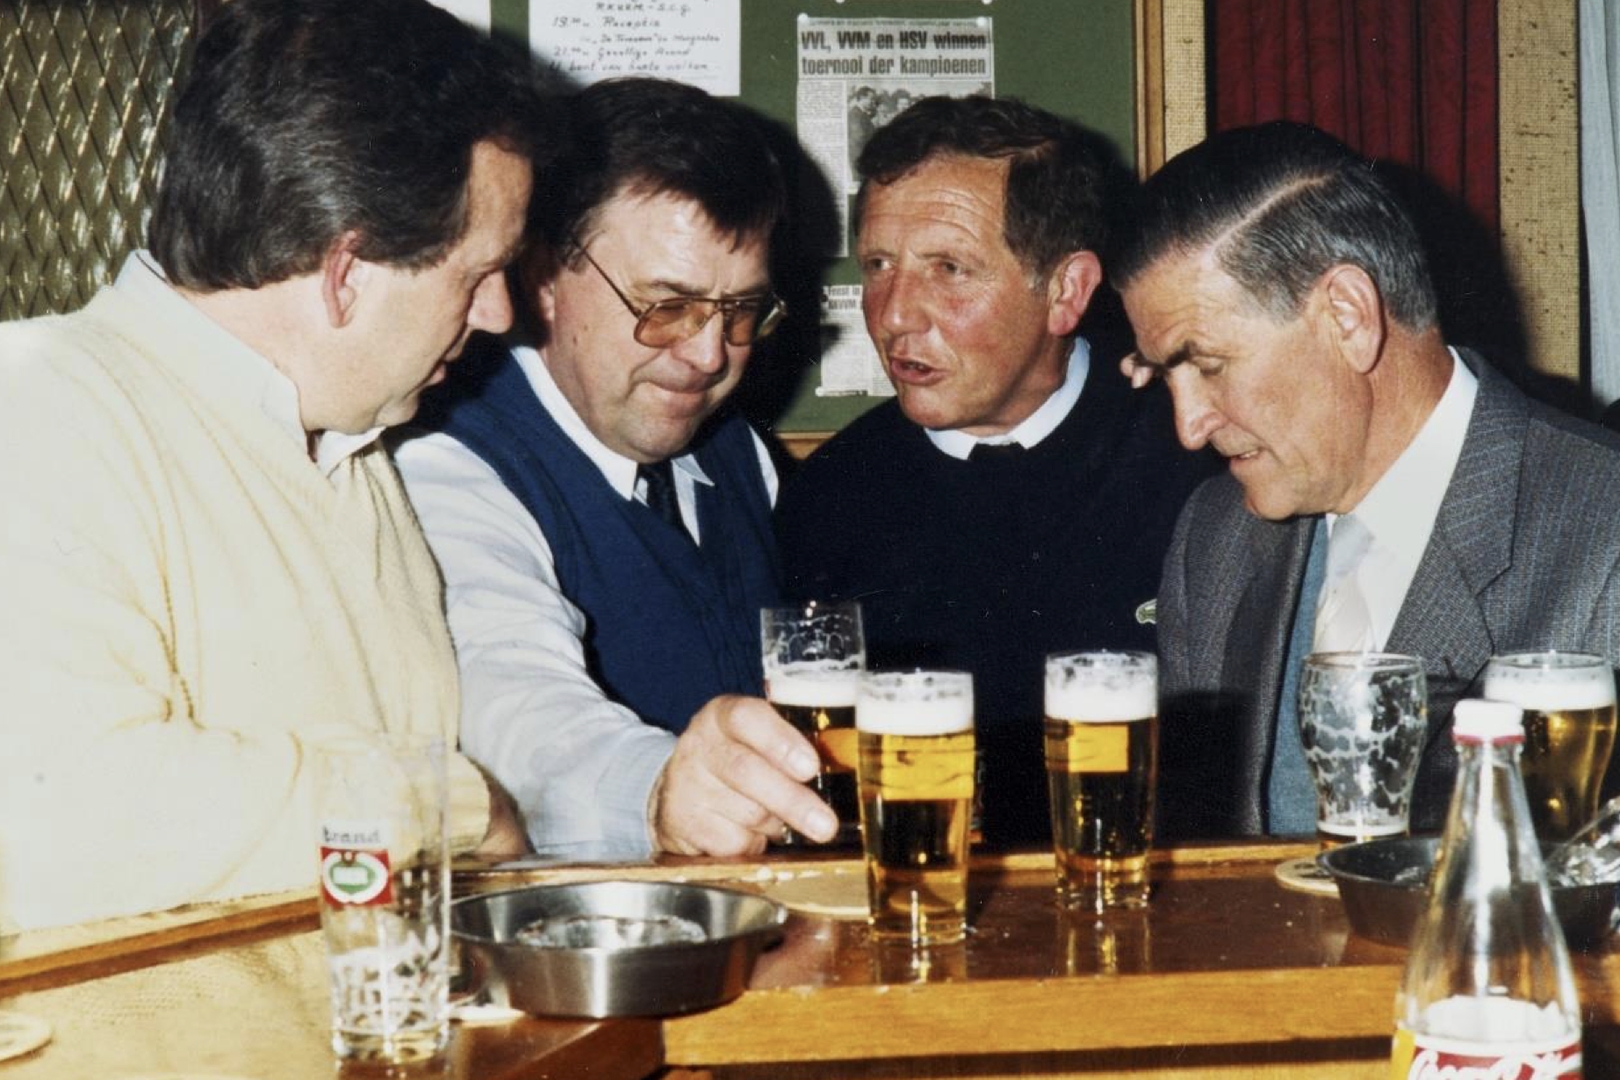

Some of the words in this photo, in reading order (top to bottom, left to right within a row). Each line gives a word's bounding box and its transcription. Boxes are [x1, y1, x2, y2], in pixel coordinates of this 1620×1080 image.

[801, 30, 832, 53] VVL,
[837, 30, 870, 50] VVM
[876, 32, 894, 50] en
[899, 30, 928, 50] HSV
[933, 30, 986, 50] winnen
[802, 55, 863, 75] toernooi
[869, 55, 894, 75] der
[900, 55, 986, 77] kampioenen
